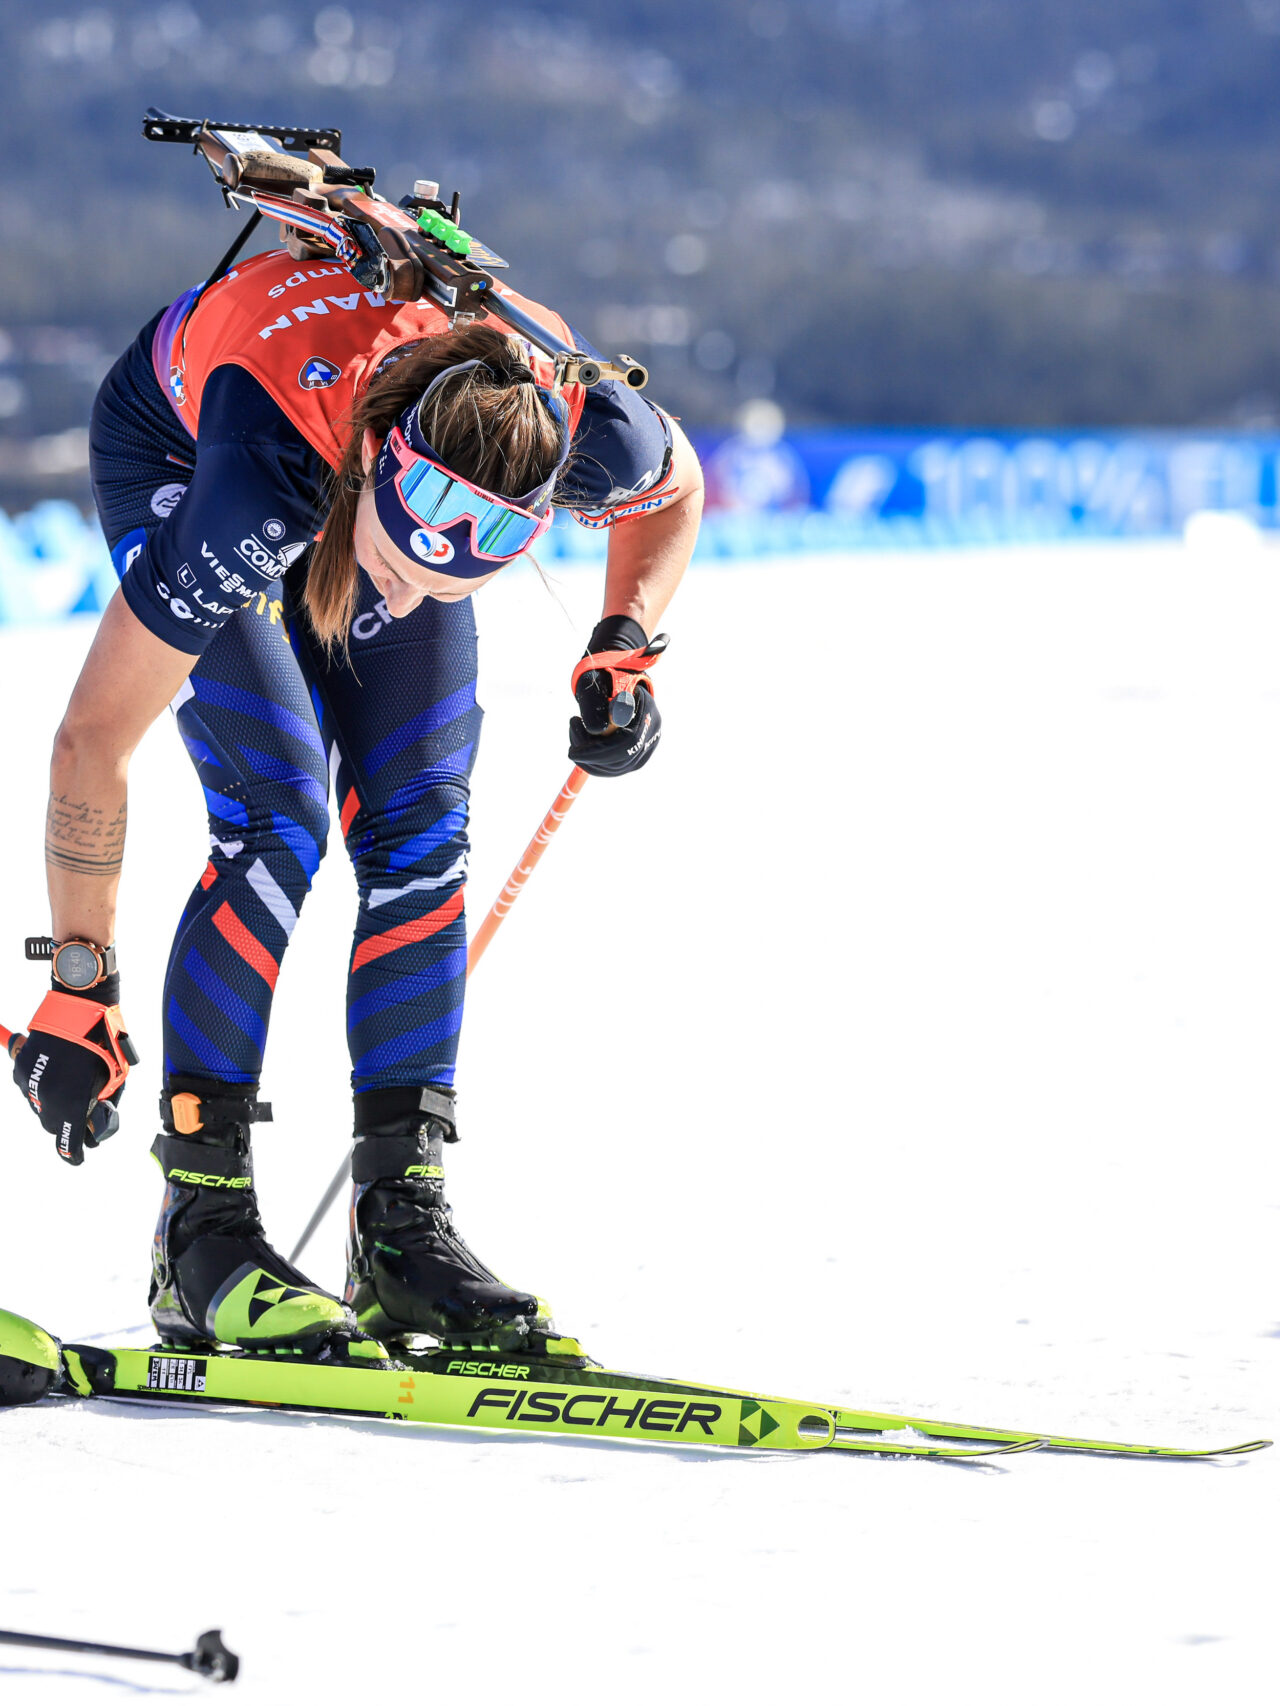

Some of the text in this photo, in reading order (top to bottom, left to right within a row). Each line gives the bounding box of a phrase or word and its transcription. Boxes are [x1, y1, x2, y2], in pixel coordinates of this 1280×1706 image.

[168, 1167, 252, 1189] FISCHER
[446, 1360, 530, 1380] FISCHER
[466, 1387, 722, 1436] FISCHER
